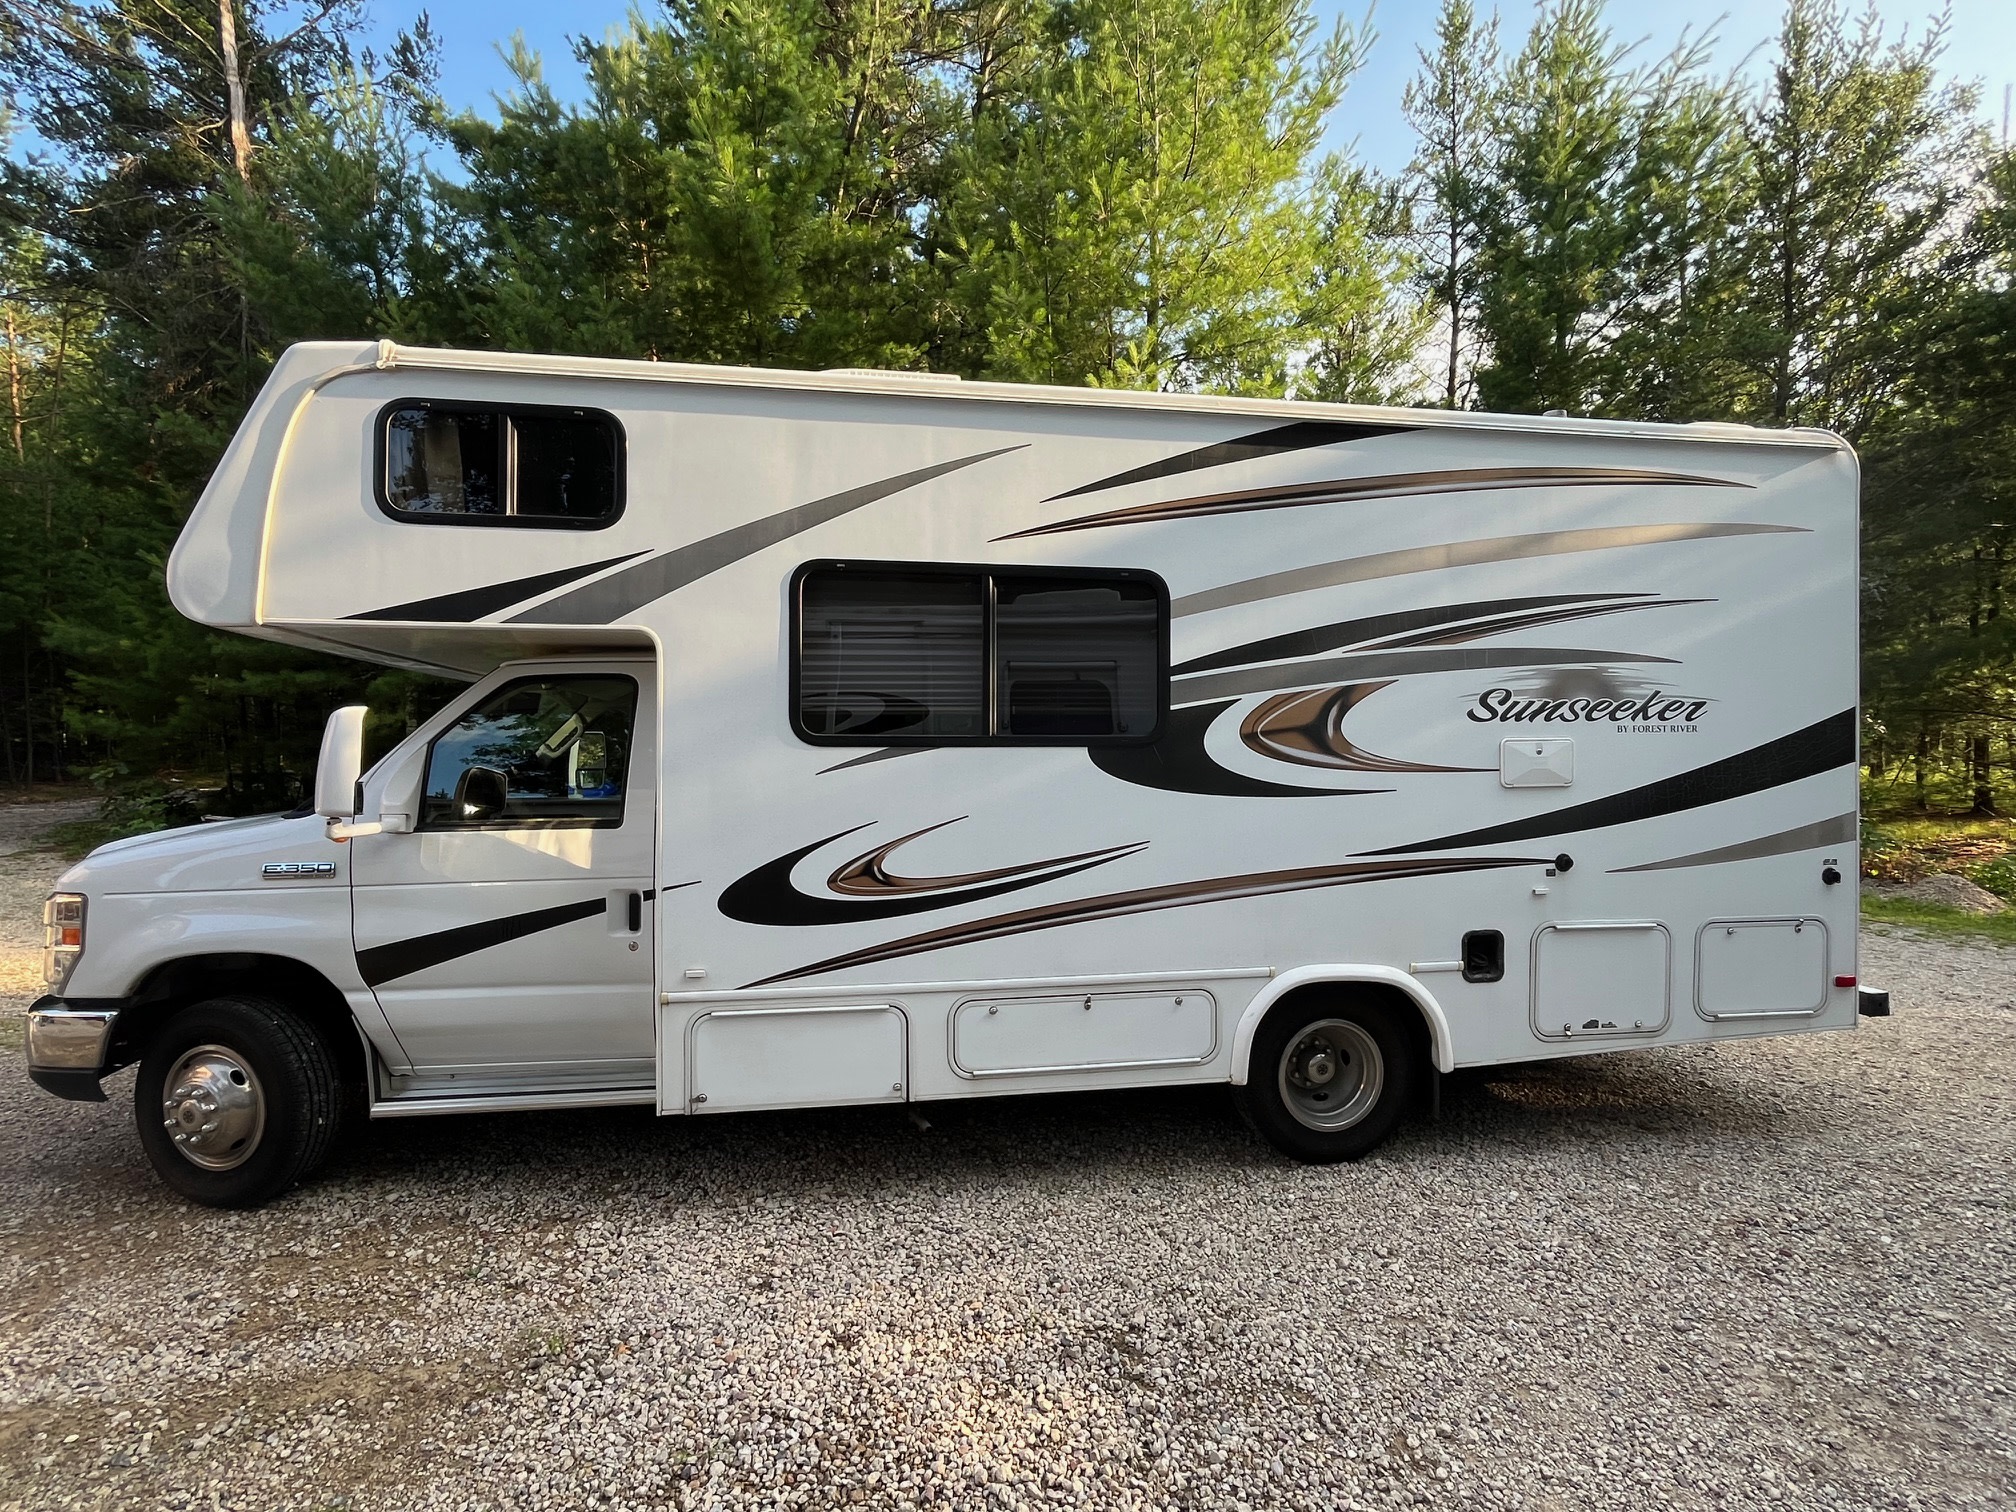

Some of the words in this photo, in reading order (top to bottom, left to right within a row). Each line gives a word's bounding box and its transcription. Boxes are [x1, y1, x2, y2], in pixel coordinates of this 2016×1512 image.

[1466, 688, 1708, 723] Sunseeker
[1617, 724, 1629, 733] BY
[1632, 724, 1667, 733] FOREST
[1670, 724, 1698, 733] RIVER
